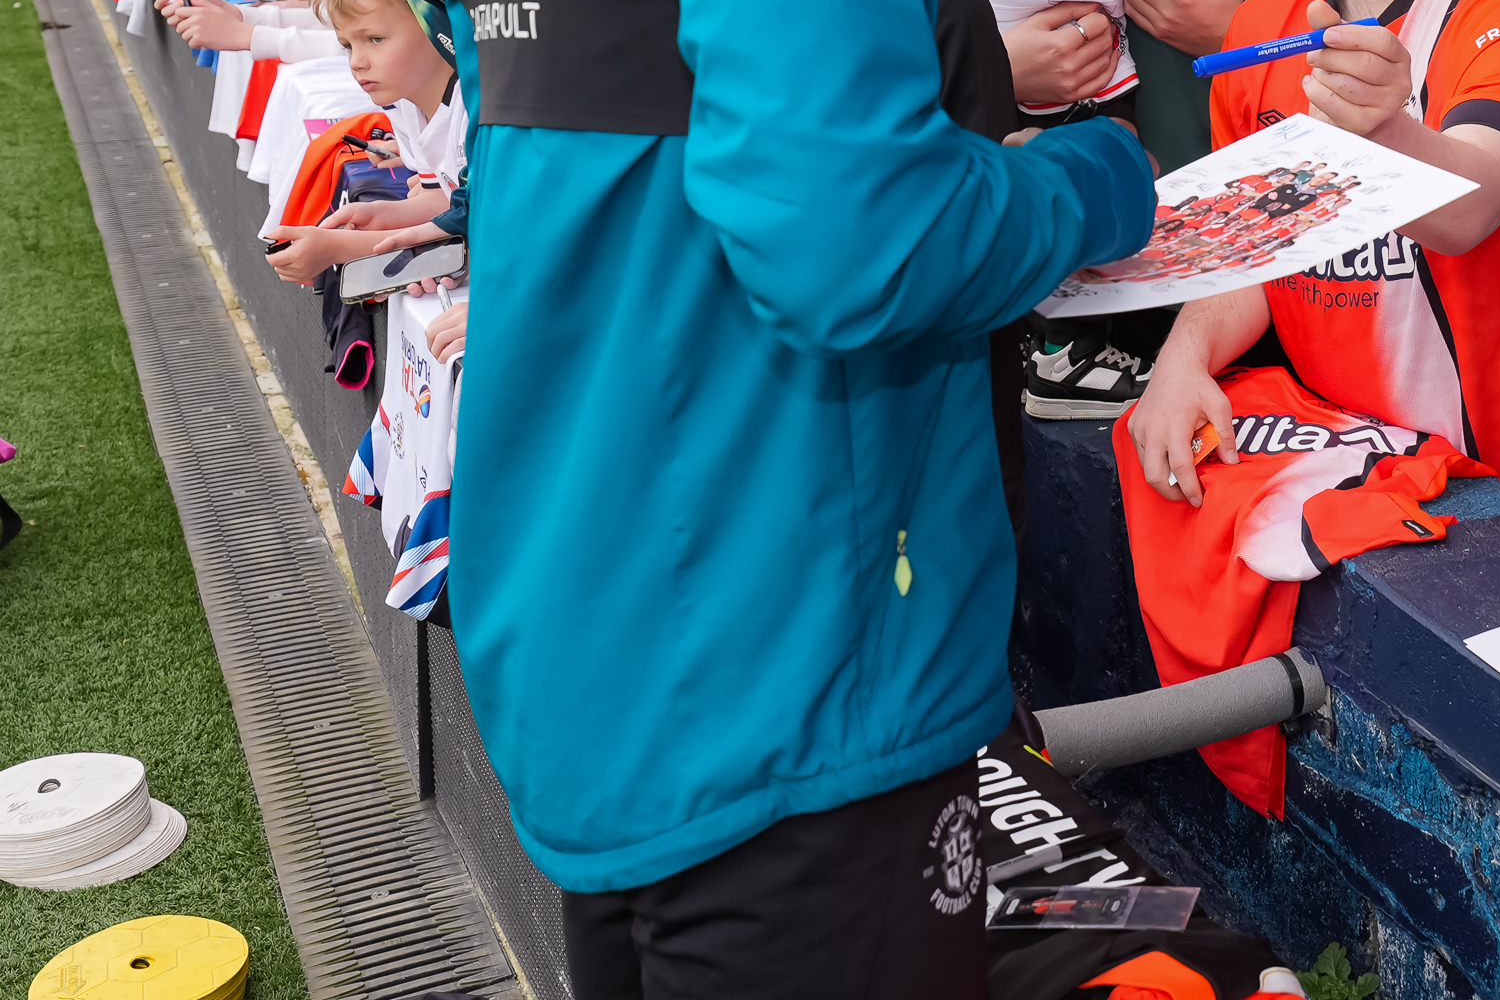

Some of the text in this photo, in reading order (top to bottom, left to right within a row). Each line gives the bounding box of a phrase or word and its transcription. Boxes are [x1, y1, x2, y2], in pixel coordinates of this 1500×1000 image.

[1257, 46, 1279, 57] Marker
[1279, 38, 1313, 53] Permanent
[928, 799, 956, 849] LUTON
